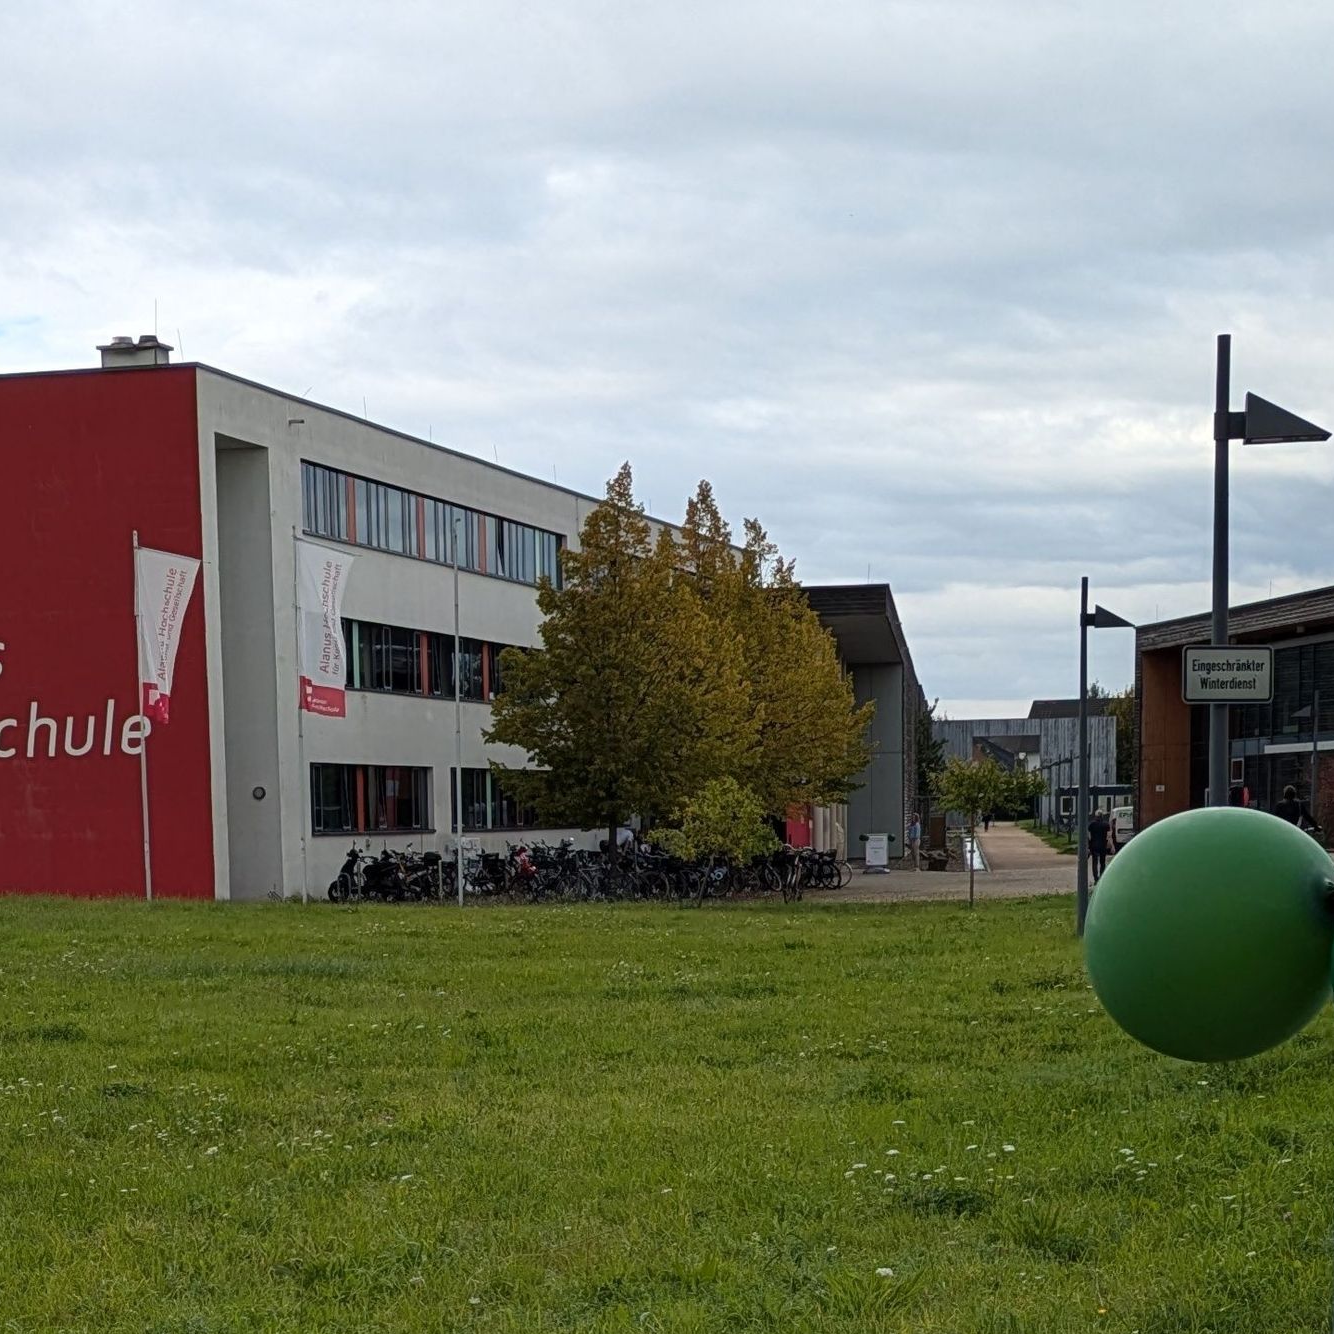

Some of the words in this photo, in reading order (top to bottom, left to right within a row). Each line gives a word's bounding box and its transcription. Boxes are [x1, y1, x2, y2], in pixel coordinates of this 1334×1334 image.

[319, 633, 332, 674] Alanus
[1192, 659, 1265, 674] Eingeschränkter
[1200, 677, 1256, 690] Winterdienst
